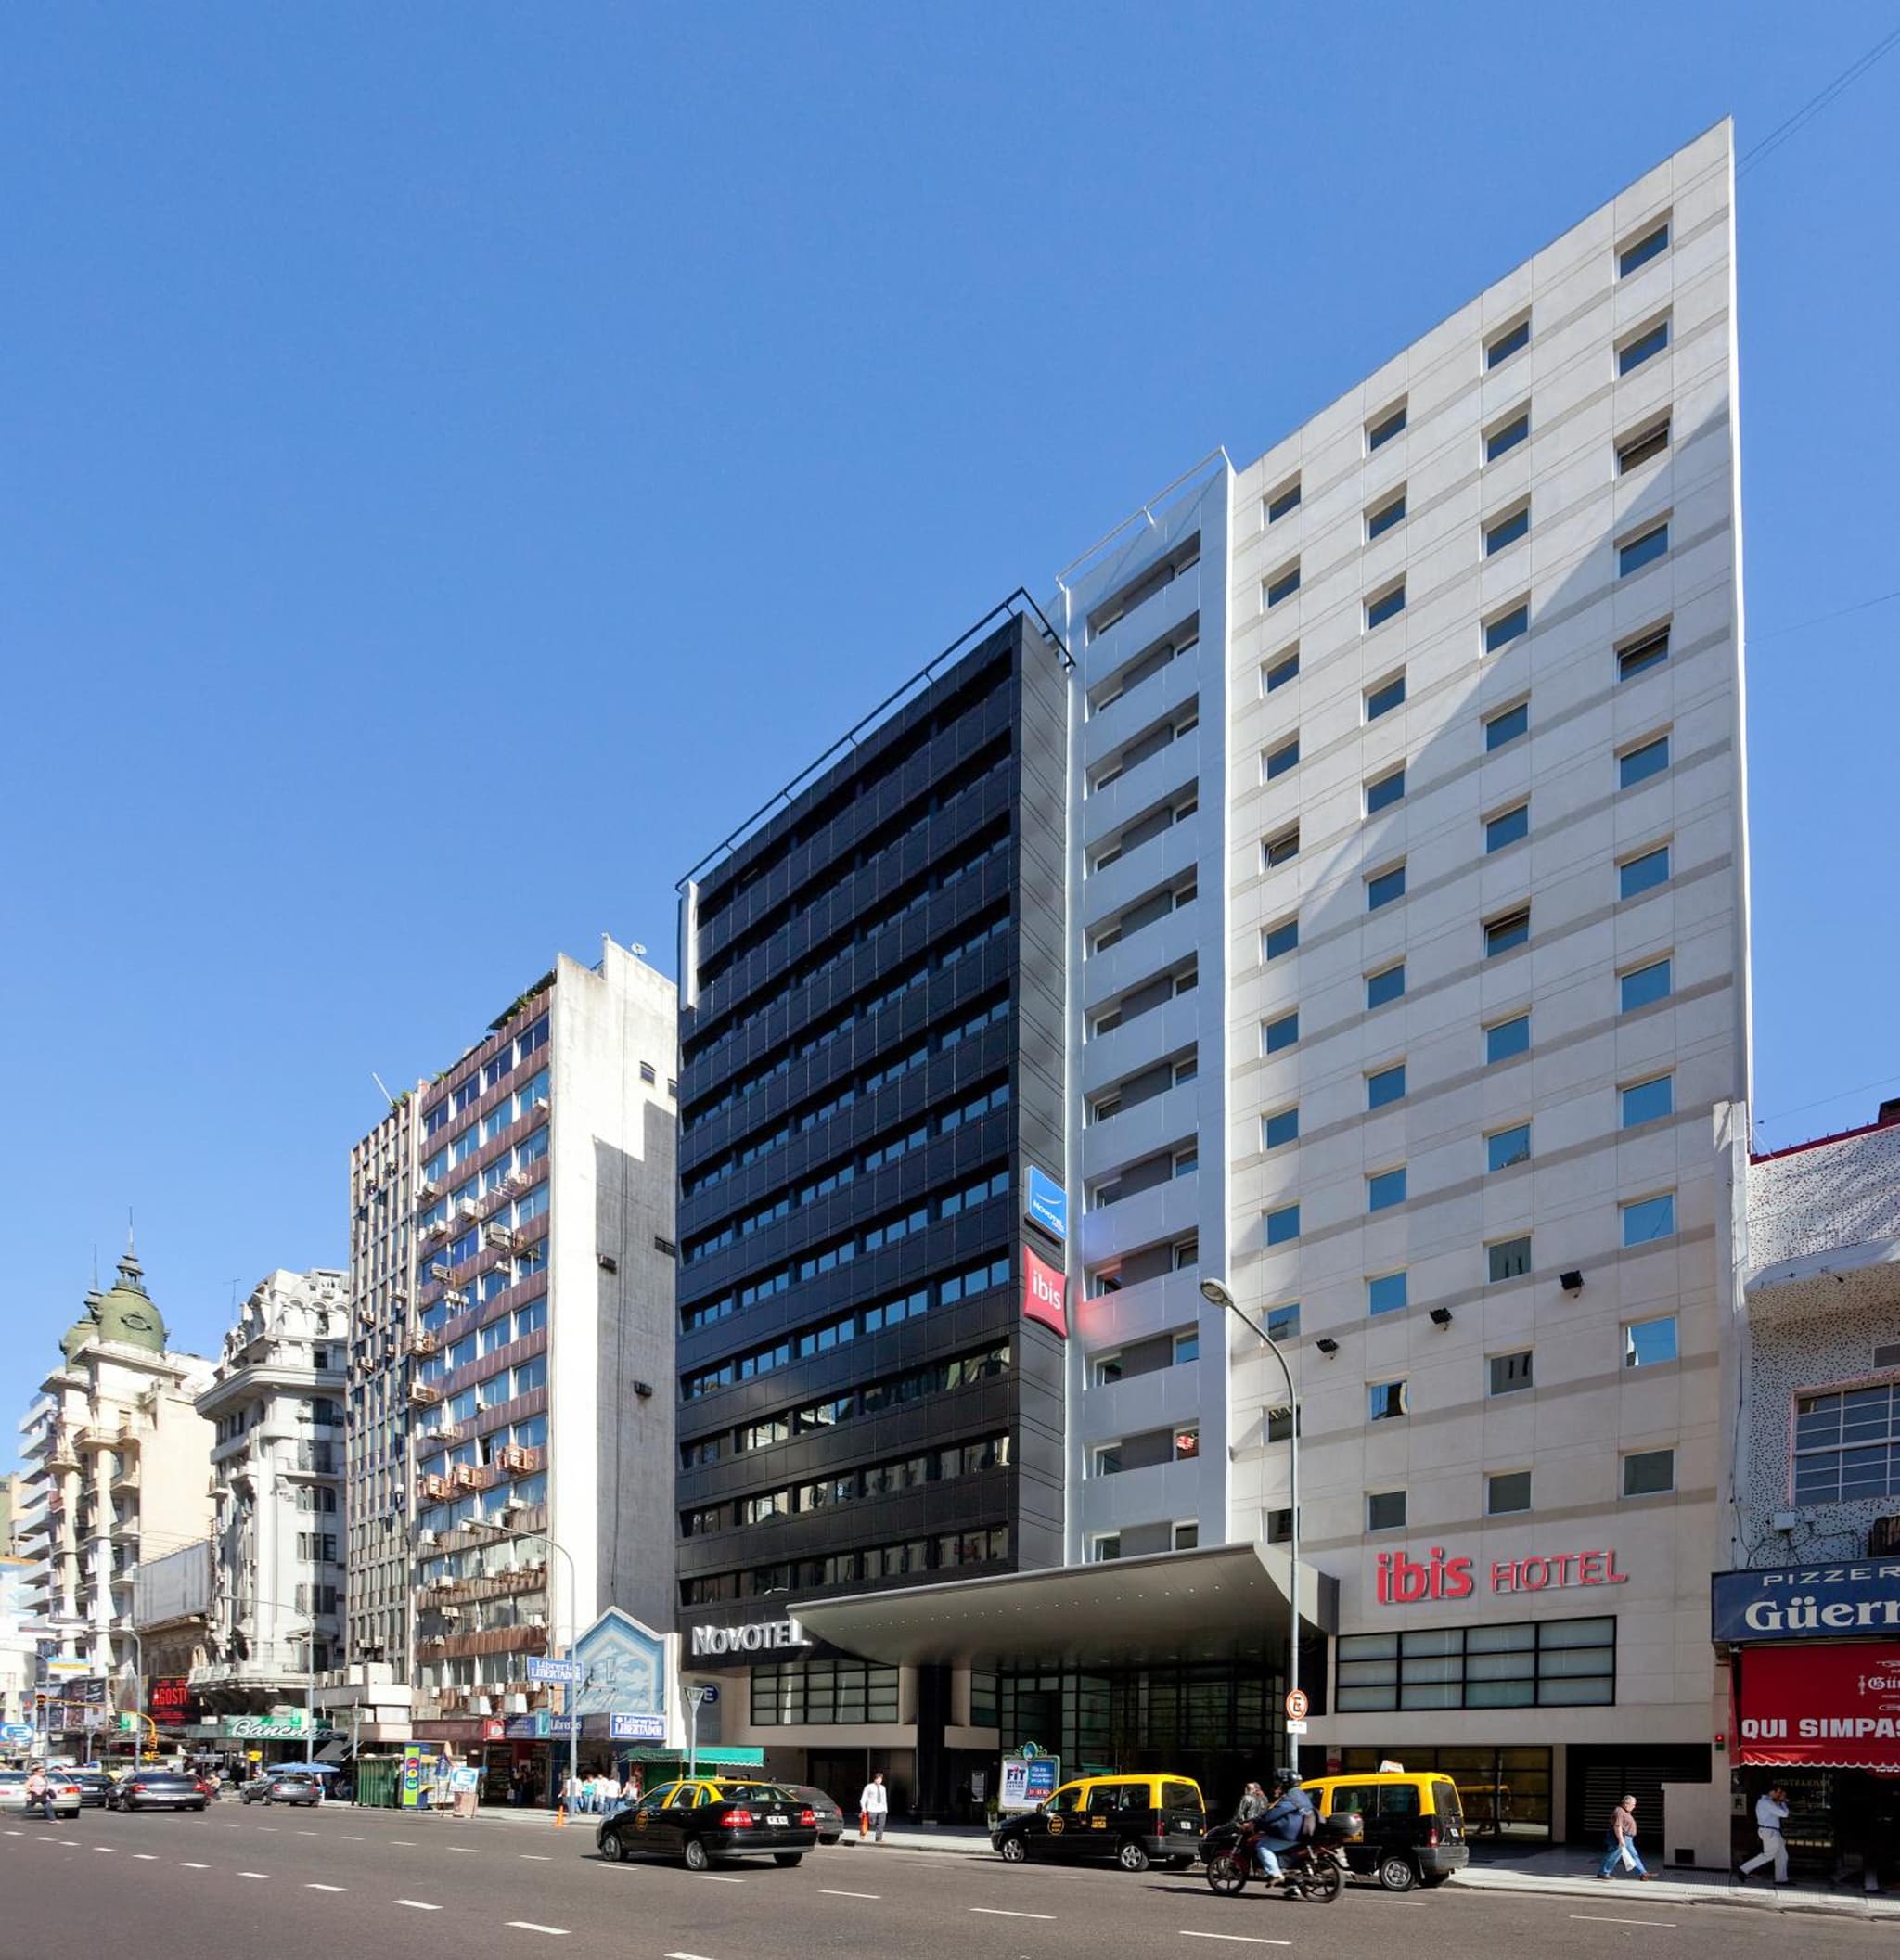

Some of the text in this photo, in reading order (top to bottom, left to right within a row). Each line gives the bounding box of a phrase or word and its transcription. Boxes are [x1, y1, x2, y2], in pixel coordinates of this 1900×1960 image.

[1033, 1269, 1061, 1311] ibis
[1377, 1547, 1629, 1605] ibis HOTEL
[692, 1618, 813, 1656] NOVOTEL
[531, 1666, 581, 1682] LIBERTADR
[1868, 1675, 1900, 1690] Gü
[703, 1686, 714, 1701] E
[1293, 1697, 1303, 1712] E
[550, 1718, 582, 1731] Librers
[615, 1722, 663, 1736] LIBERTADOR
[1741, 1718, 1900, 1740] QUI SIMPA
